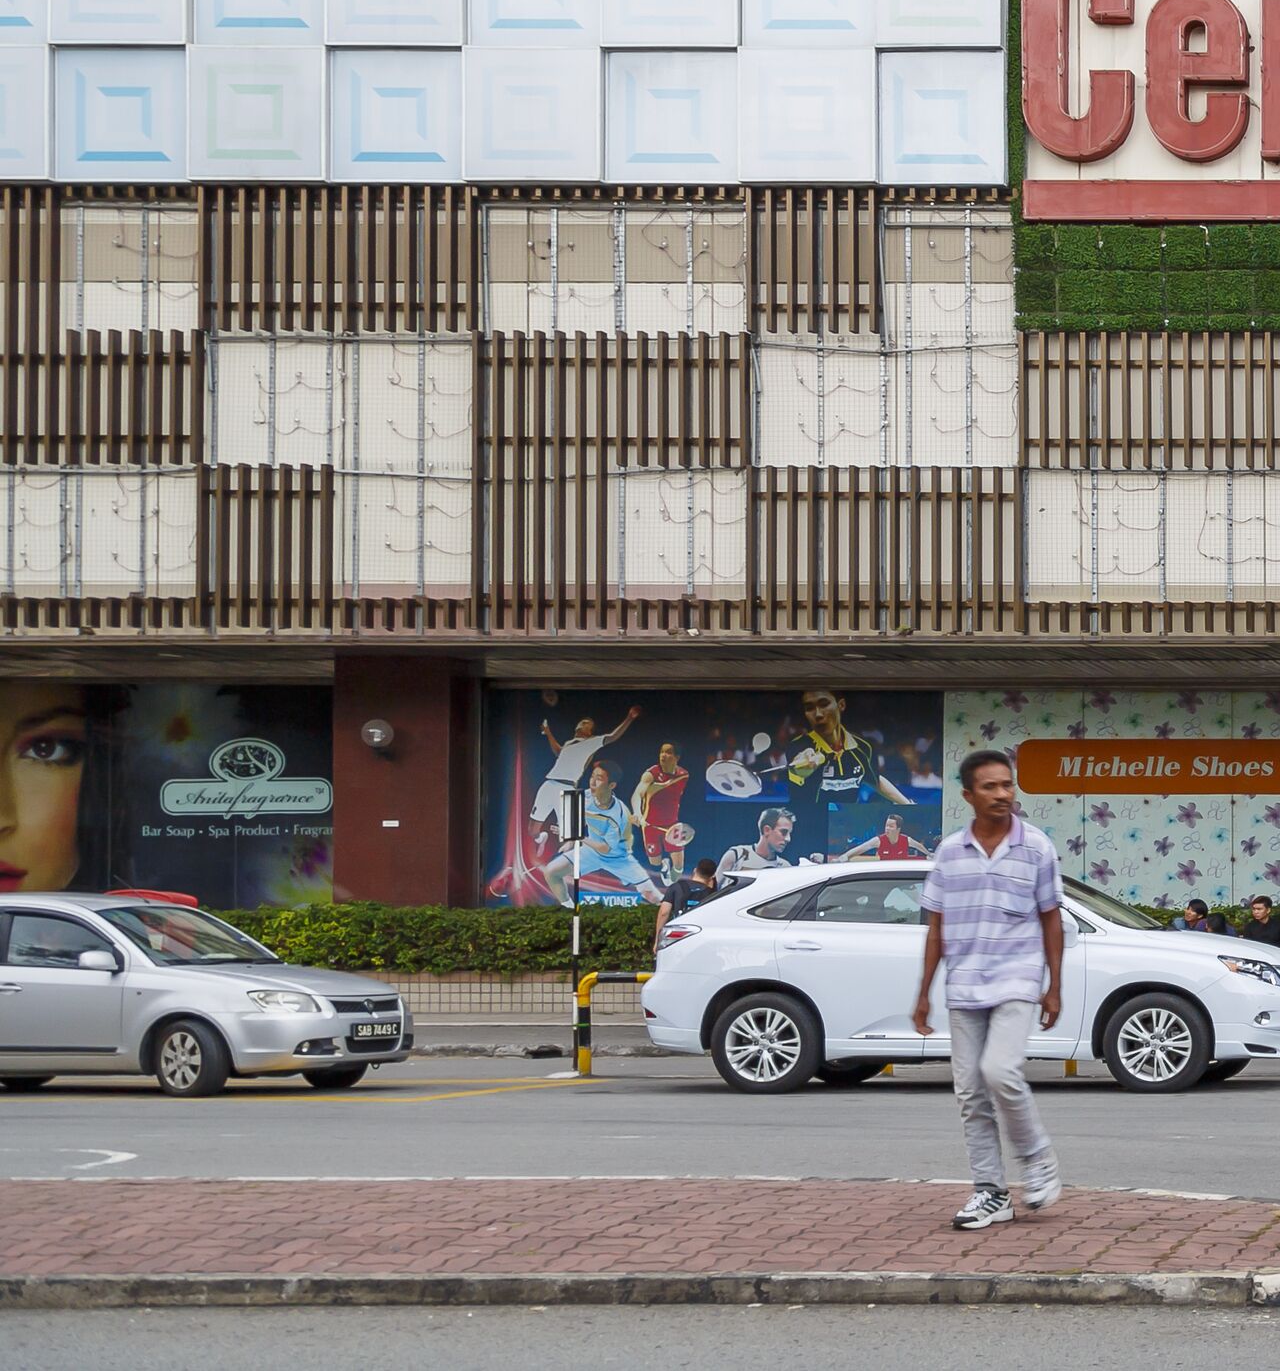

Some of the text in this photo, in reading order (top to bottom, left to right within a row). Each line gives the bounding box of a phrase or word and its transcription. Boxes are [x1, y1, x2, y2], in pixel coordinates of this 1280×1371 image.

[1056, 755, 1275, 777] Michelle Shoes
[175, 782, 315, 818] Anitafragrance
[142, 825, 162, 837] Bar
[166, 825, 195, 839] Soap
[208, 825, 230, 839] Spa
[234, 824, 280, 837] Product
[602, 895, 639, 907] YONEX
[358, 1024, 372, 1036] SAB
[374, 1023, 392, 1036] 7449
